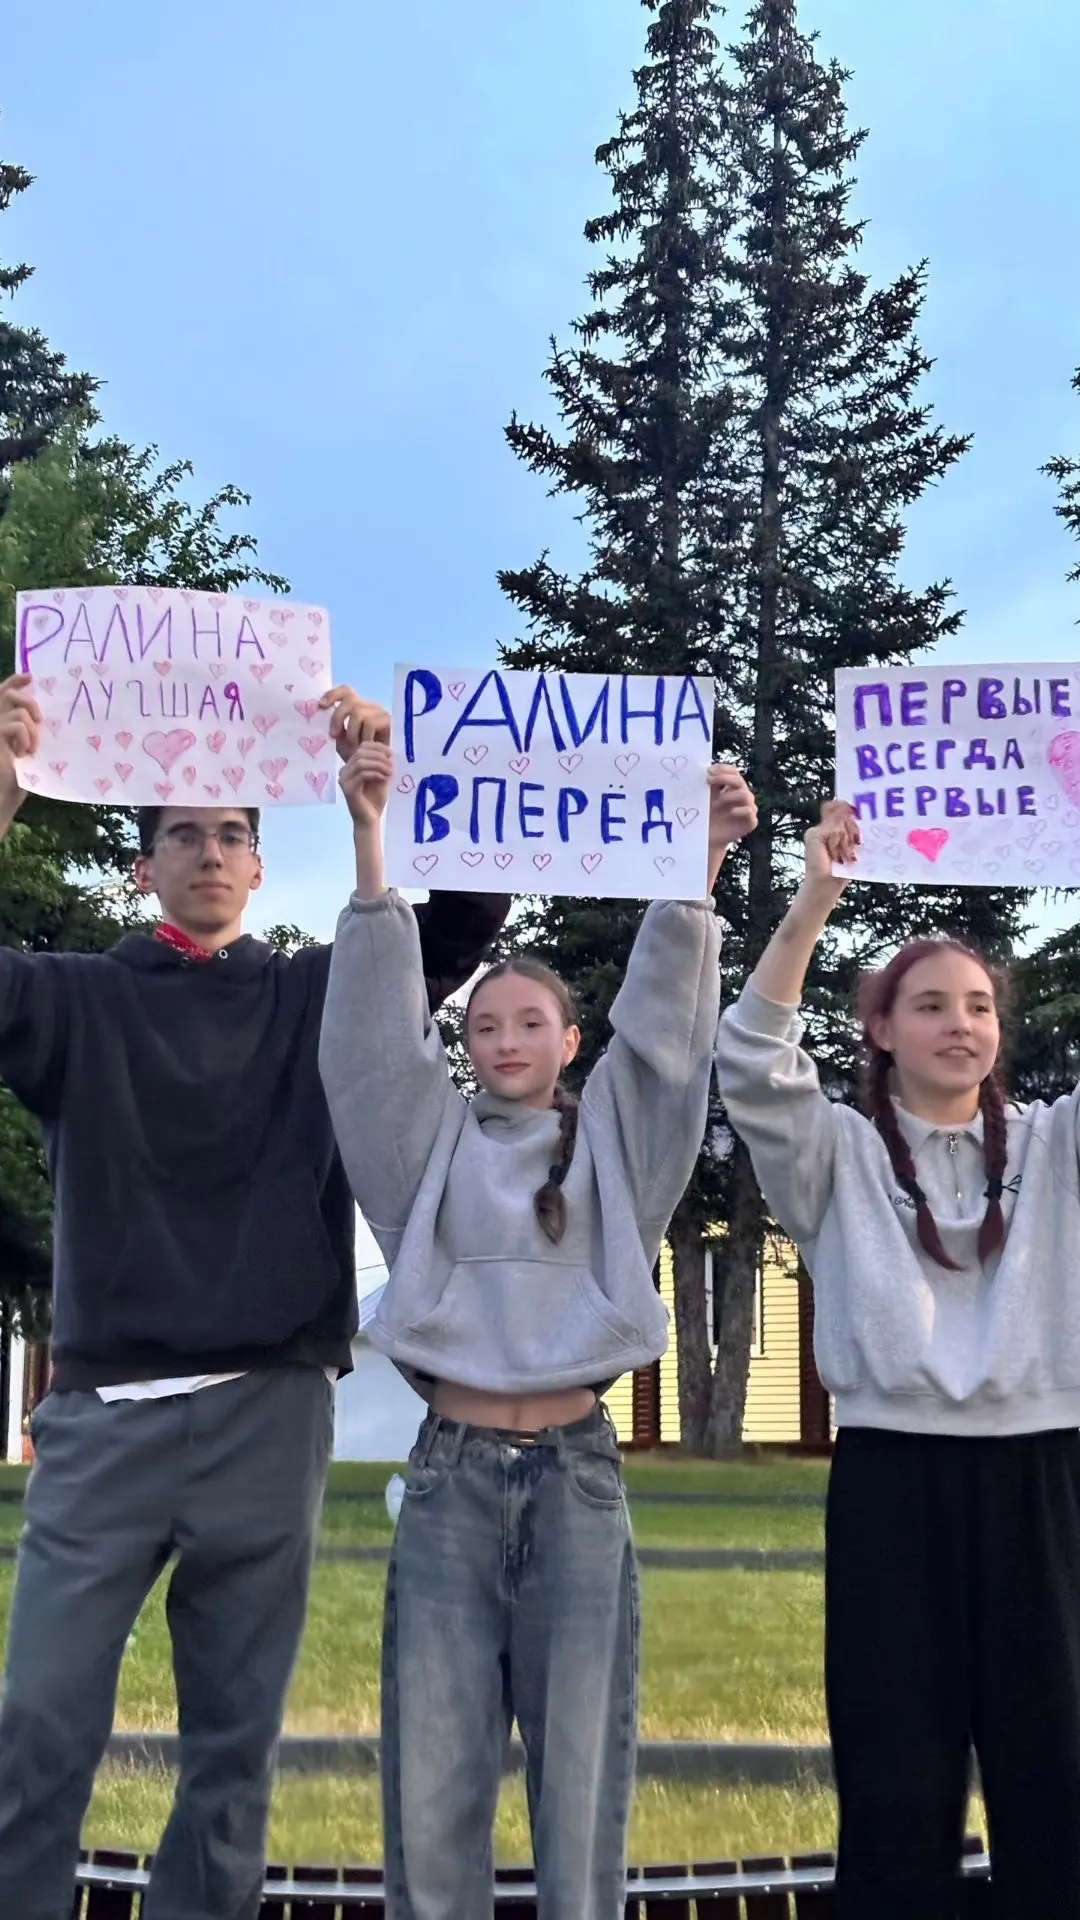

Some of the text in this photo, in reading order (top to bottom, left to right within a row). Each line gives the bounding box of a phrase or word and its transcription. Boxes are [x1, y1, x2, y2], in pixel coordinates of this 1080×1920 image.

[20, 603, 265, 674] РАЛИНА
[404, 669, 710, 763] РАЛИНА
[853, 677, 1072, 731] ПЕРВЫЕ
[855, 738, 1024, 780] ВСЕГДА
[414, 773, 673, 844] ВПЕРЁД
[852, 785, 1037, 820] ПЕРВЫЕ
